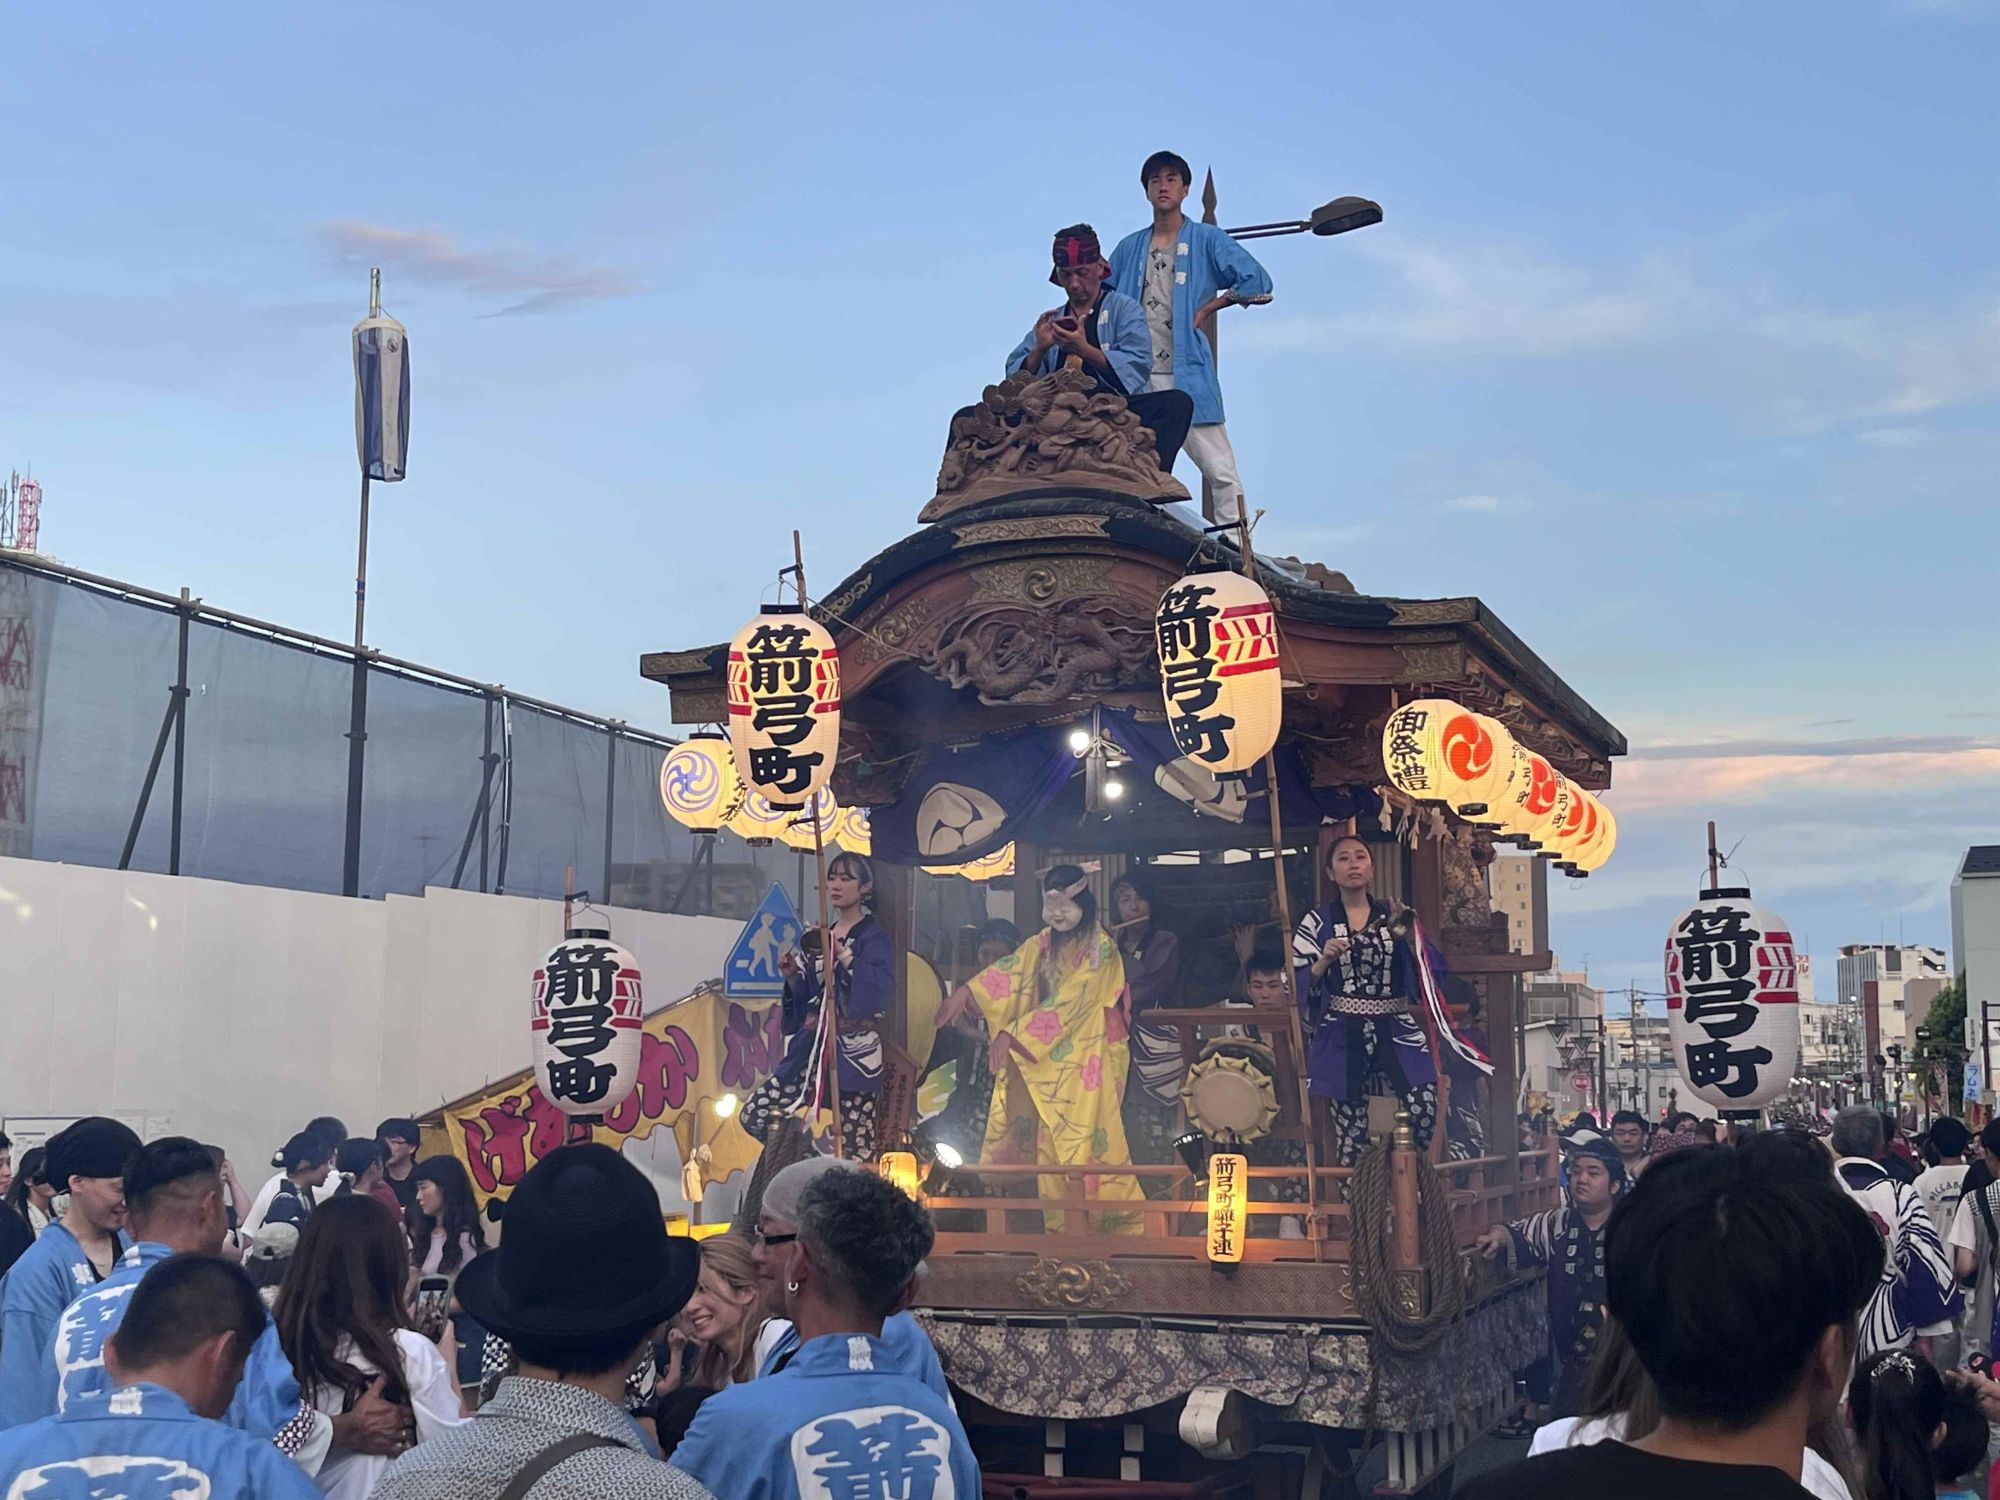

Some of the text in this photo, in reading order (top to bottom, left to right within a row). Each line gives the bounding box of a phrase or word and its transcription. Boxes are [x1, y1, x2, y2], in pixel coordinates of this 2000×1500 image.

[747, 624, 824, 794] 箭弓町
[1157, 584, 1235, 762] 箭弓町
[1387, 706, 1432, 791] 御祭禮
[545, 944, 622, 1104] 箭弓町
[1675, 906, 1773, 1098] 箭弓町
